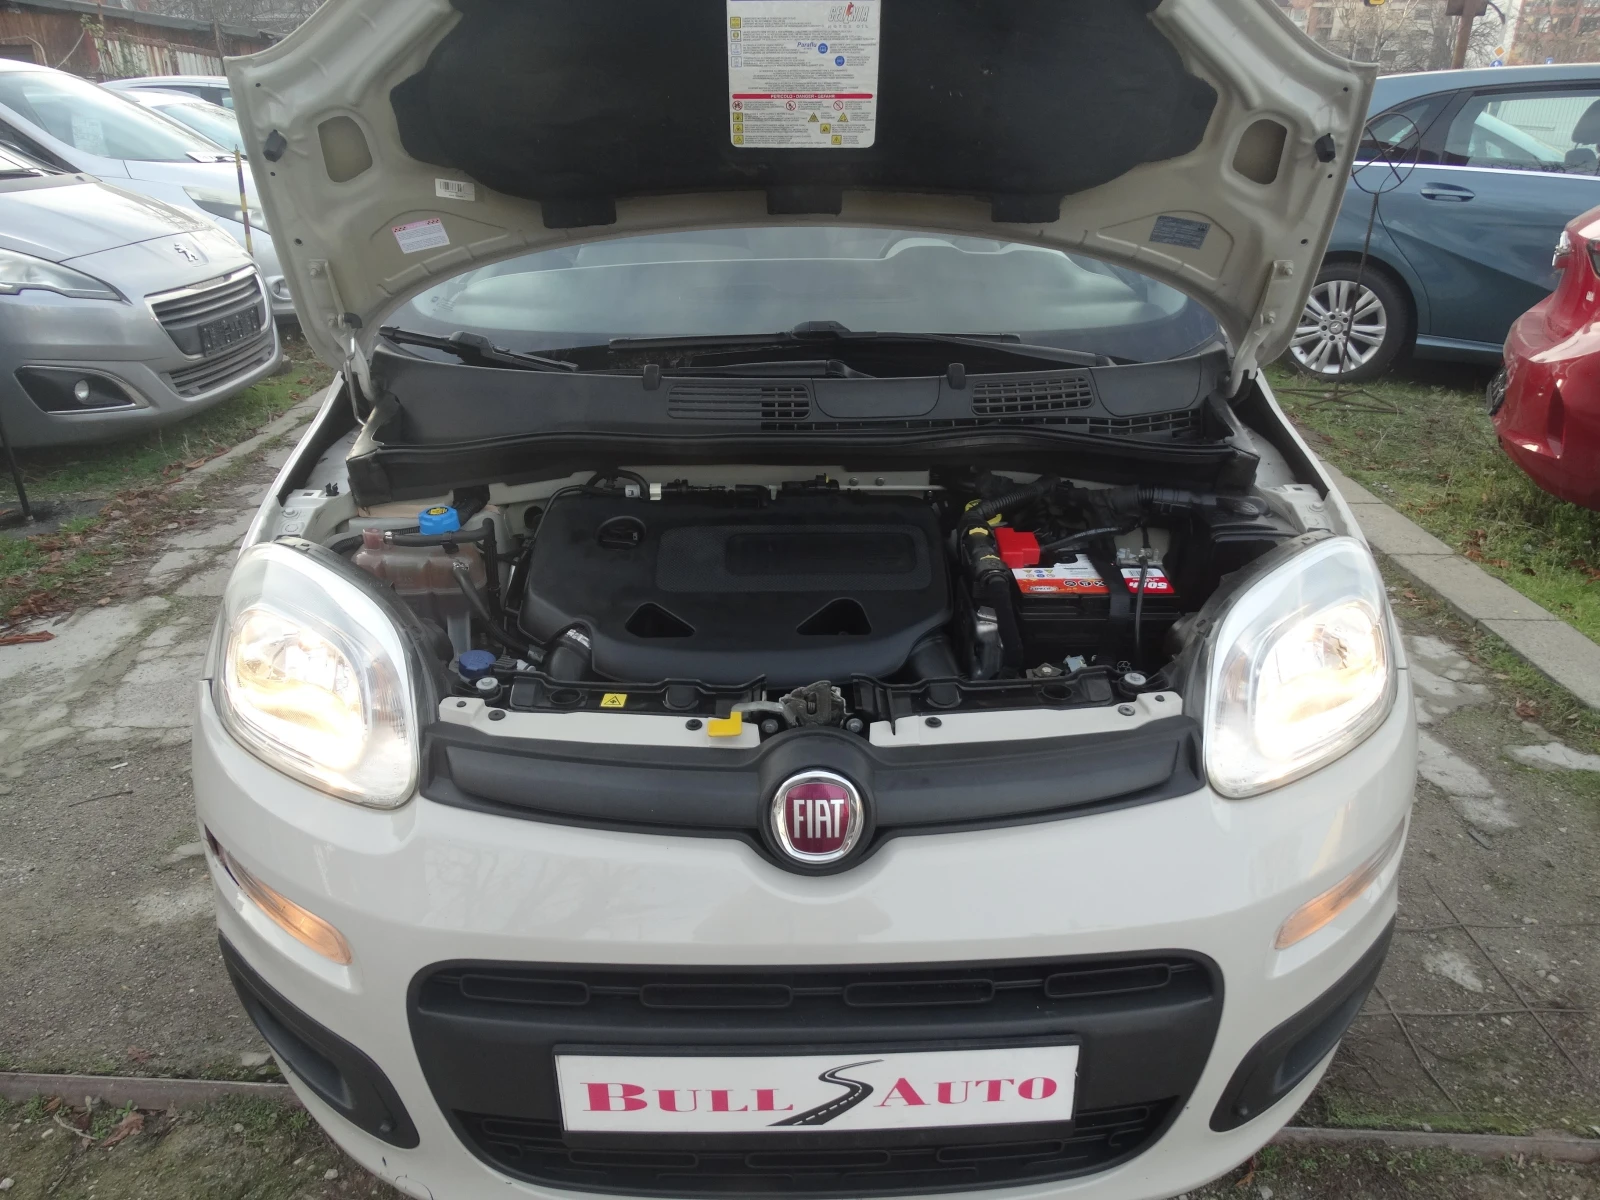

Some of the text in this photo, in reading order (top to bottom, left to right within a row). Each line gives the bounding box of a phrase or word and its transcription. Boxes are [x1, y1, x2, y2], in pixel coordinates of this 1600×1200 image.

[793, 799, 845, 839] FIAT
[580, 1076, 1057, 1112] BULL AUTO
